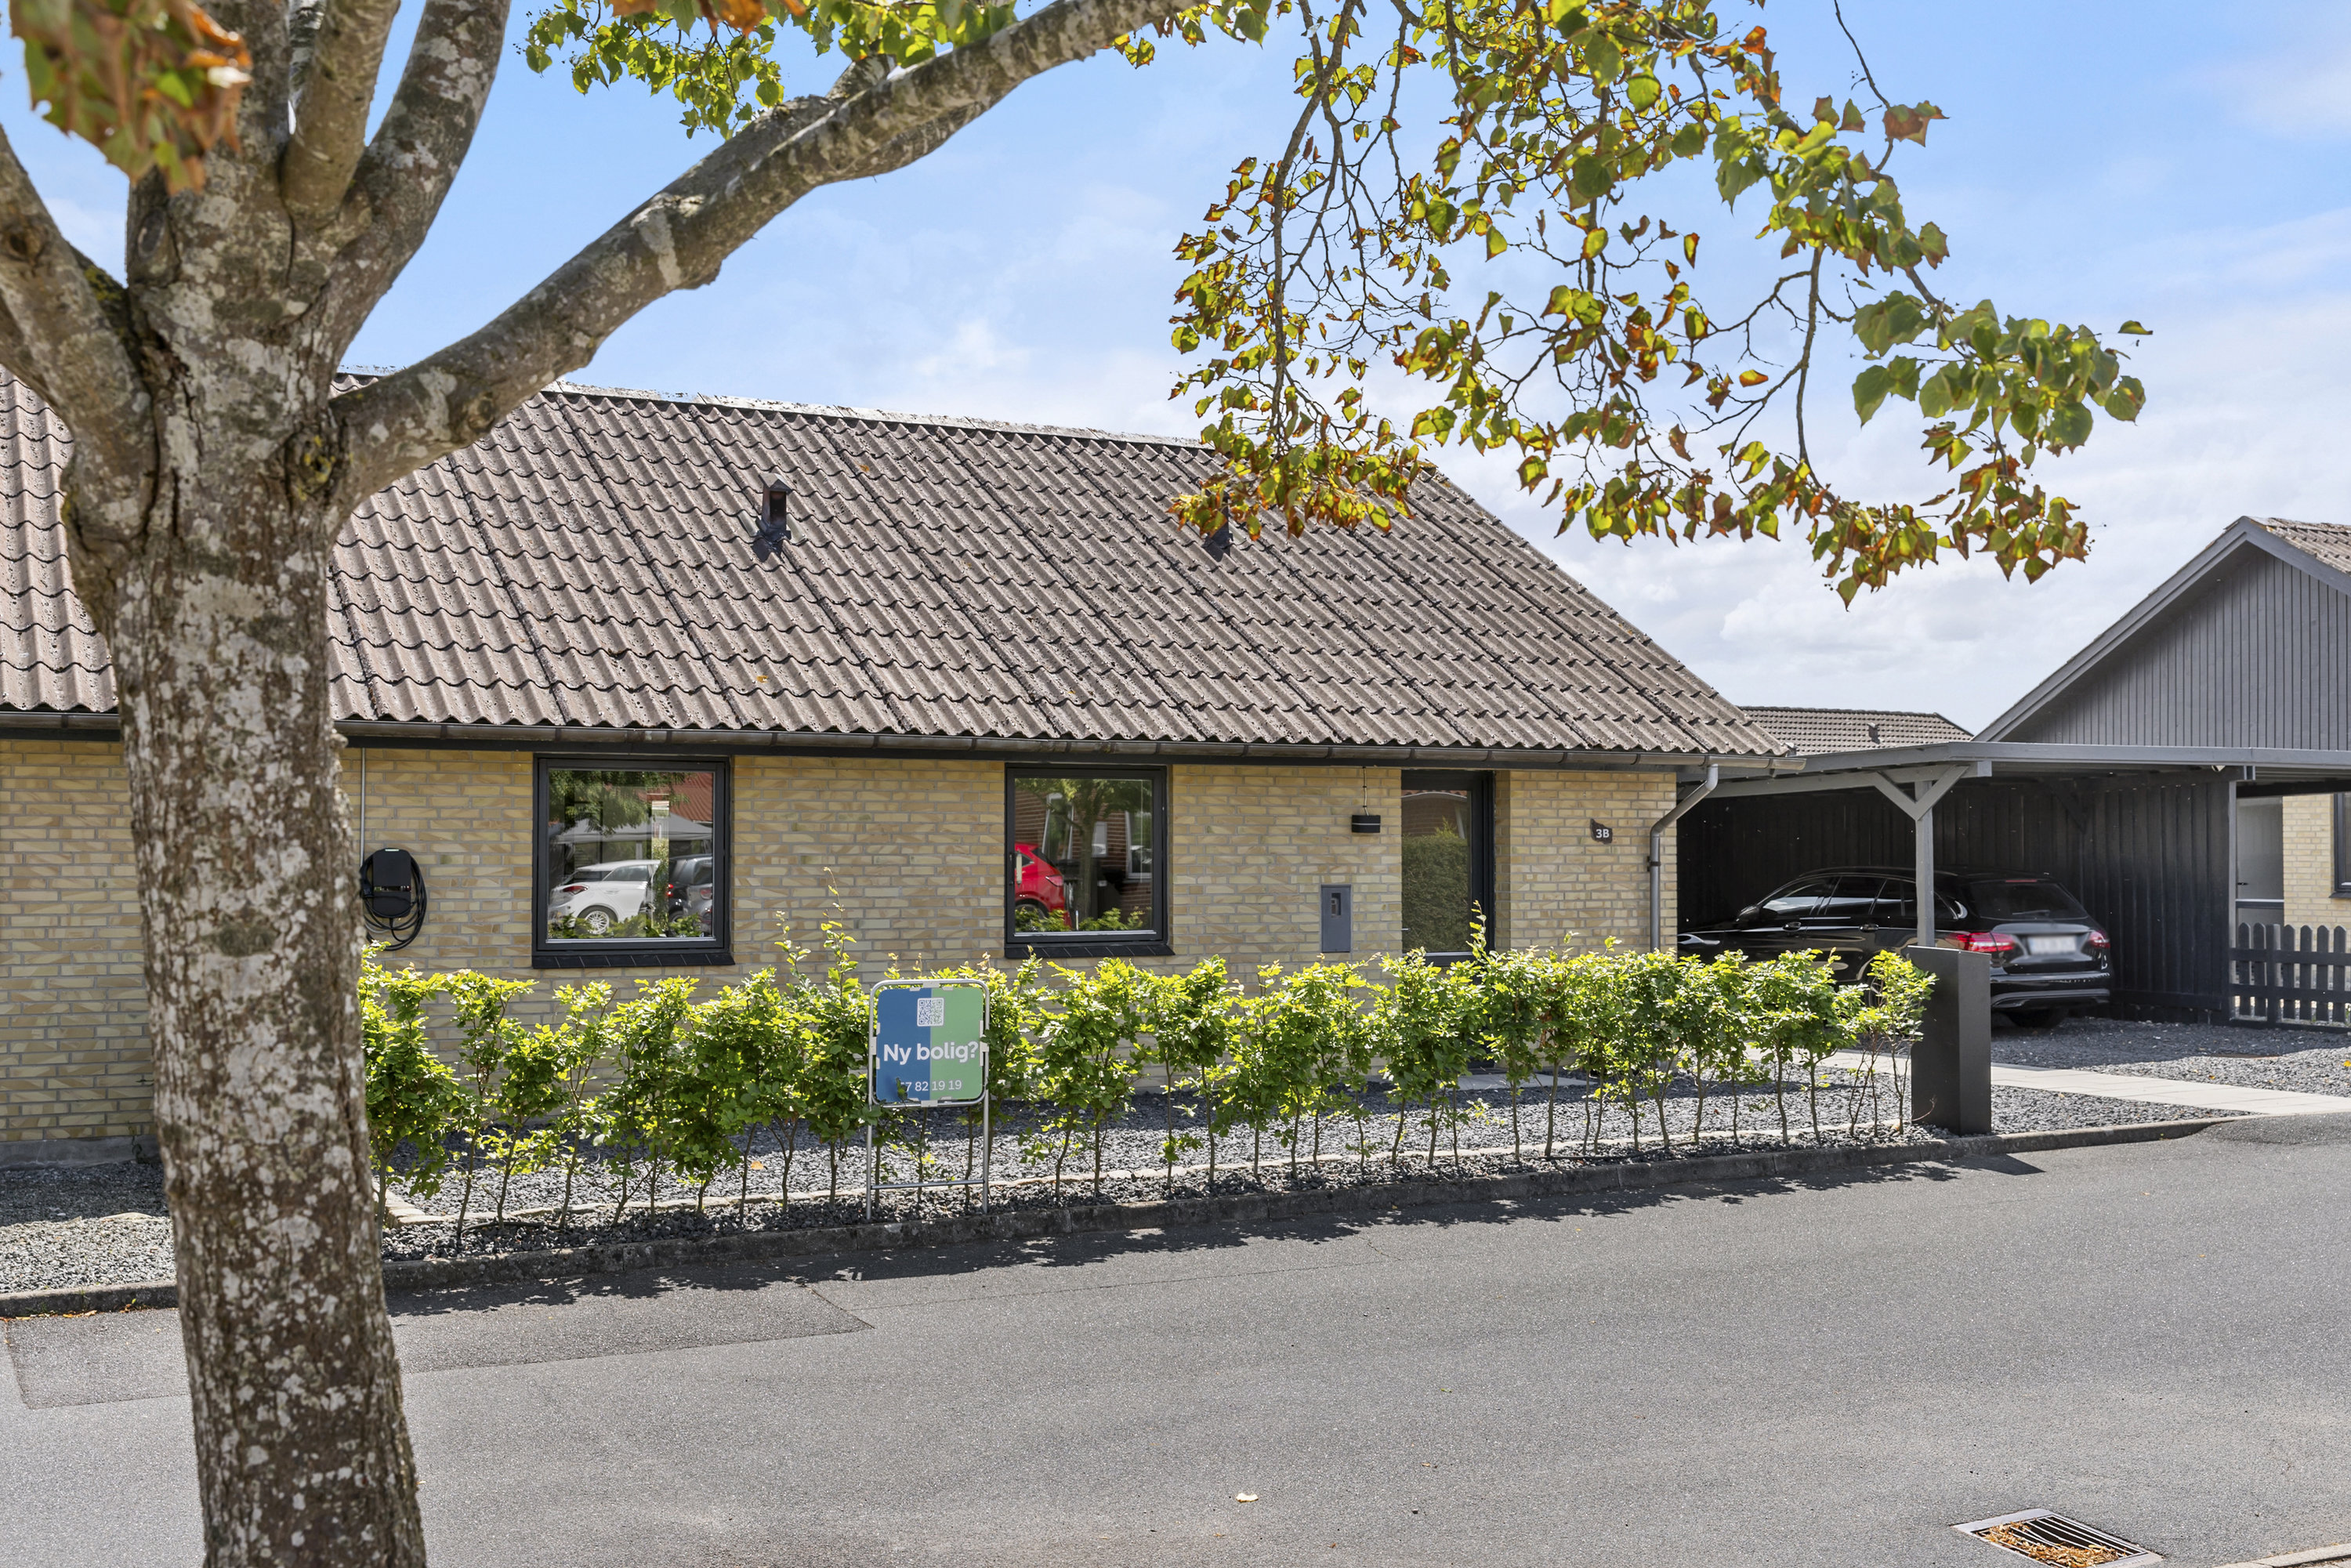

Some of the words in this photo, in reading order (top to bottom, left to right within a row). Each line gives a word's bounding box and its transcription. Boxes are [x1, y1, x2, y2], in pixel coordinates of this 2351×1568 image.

[1596, 828, 1610, 838] 3B
[883, 1044, 911, 1065] Ny
[917, 1041, 979, 1063] bolig?
[900, 1081, 912, 1092] 7
[915, 1081, 929, 1092] 82
[932, 1080, 946, 1091] 19
[948, 1079, 962, 1090] 19
